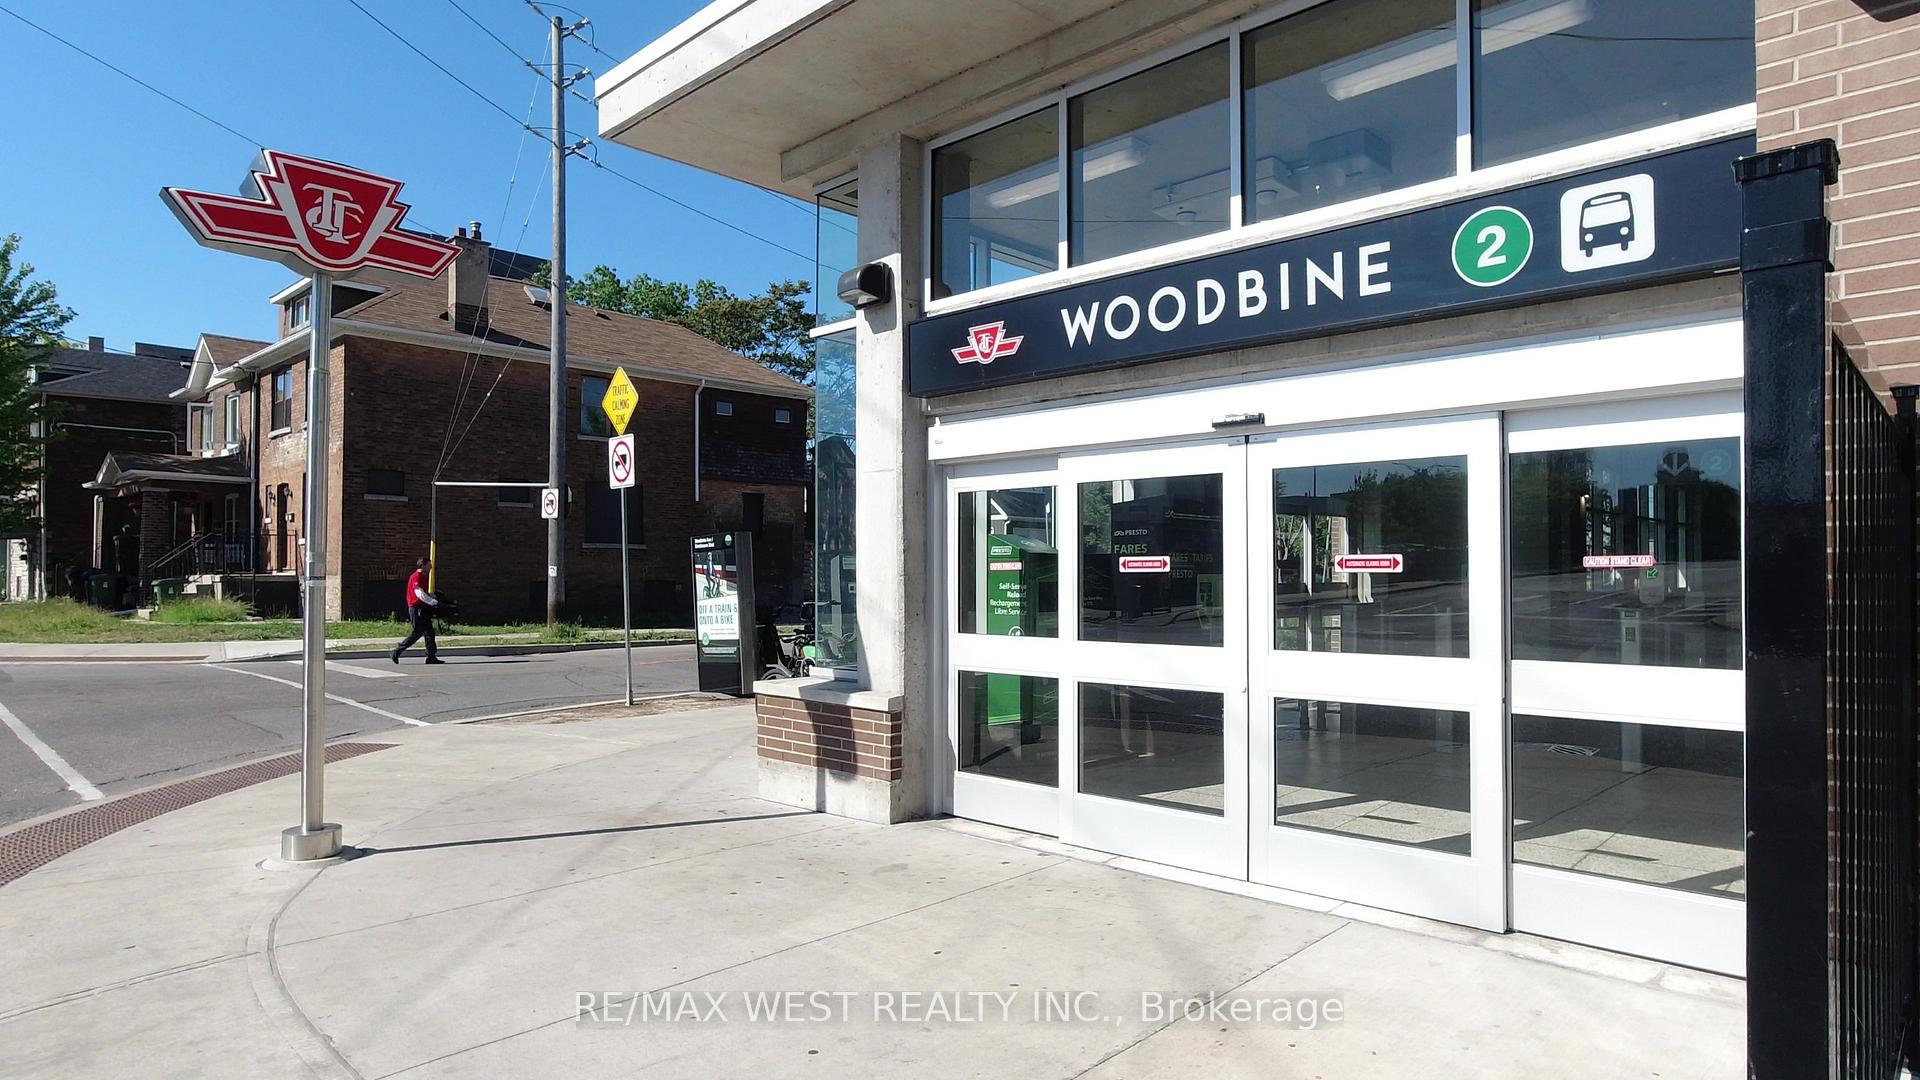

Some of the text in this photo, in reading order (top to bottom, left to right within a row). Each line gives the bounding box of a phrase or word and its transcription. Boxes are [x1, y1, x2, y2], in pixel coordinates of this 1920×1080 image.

[1477, 225, 1508, 268] 2
[1060, 241, 1391, 349] WOODBINE
[612, 384, 629, 396] TRAFFIC
[612, 399, 629, 411] CALMING
[616, 414, 626, 425] ZONE
[1114, 544, 1147, 554] FARES
[1586, 555, 1650, 565] CAUTION STAND CLEAR
[999, 583, 1027, 591] Self-Serve
[699, 604, 707, 614] OFF
[709, 605, 714, 613] A
[715, 603, 732, 614] TRAIN
[699, 614, 733, 625] ONTO A BIKE
